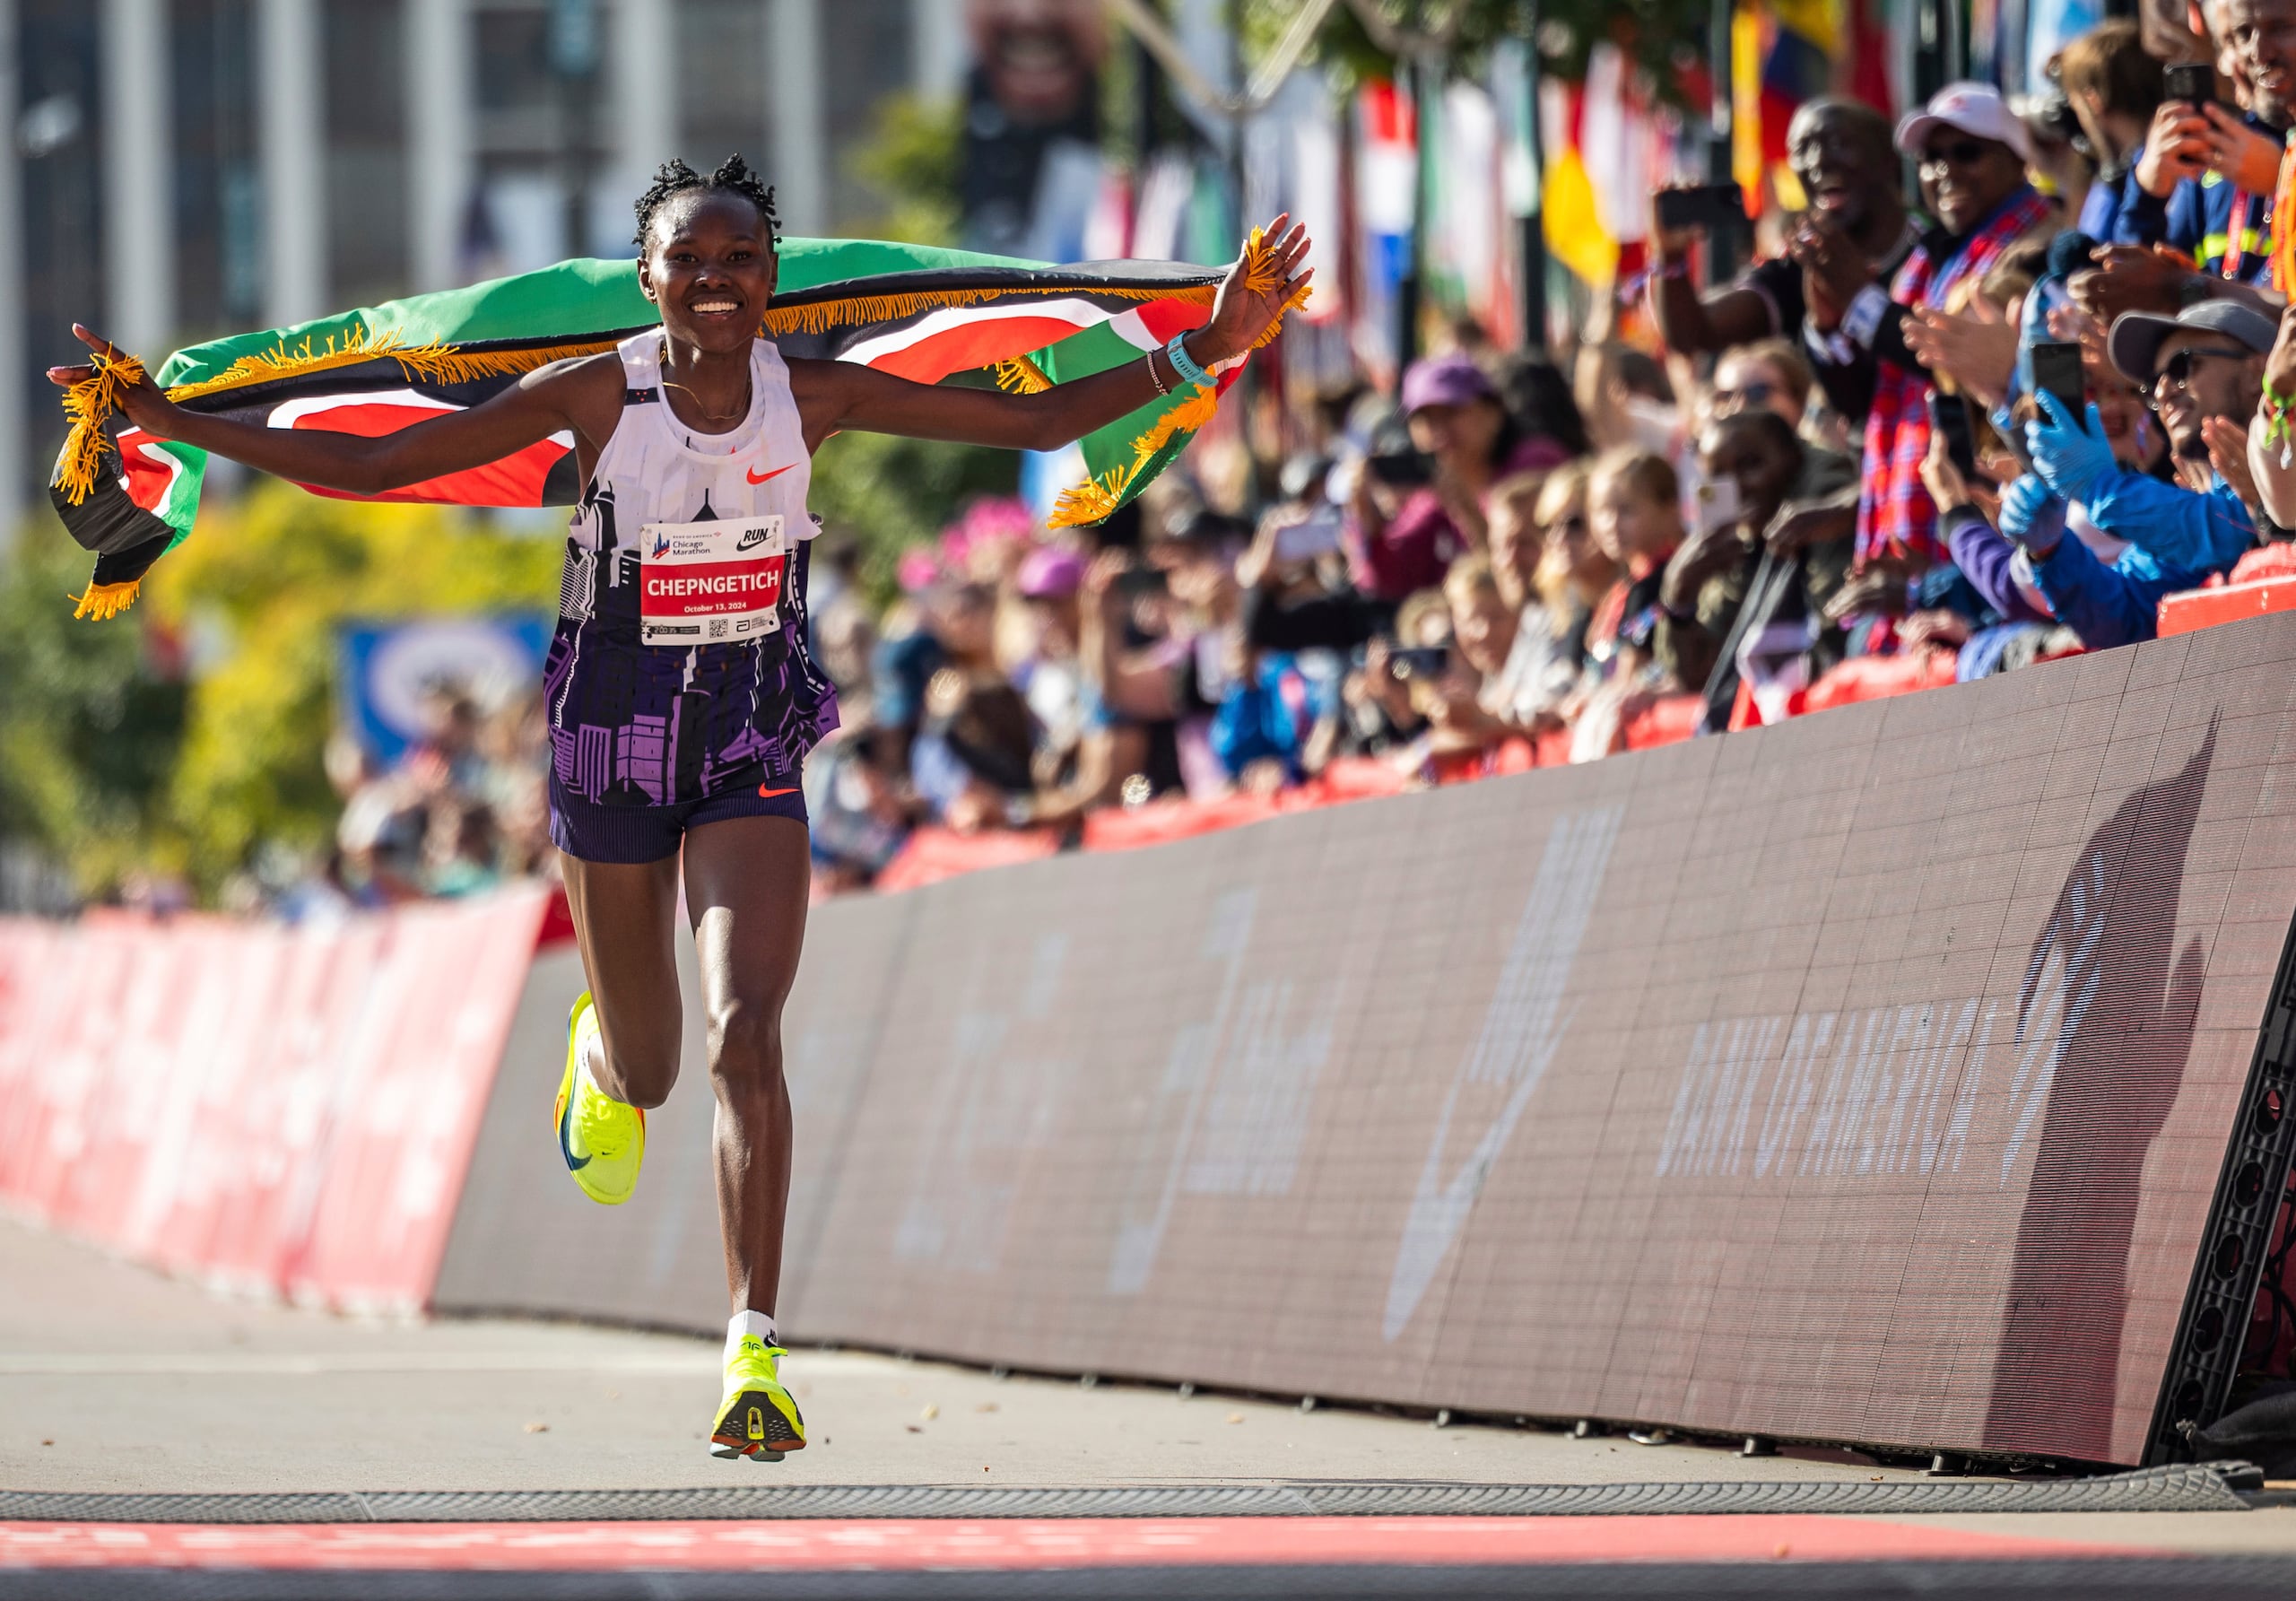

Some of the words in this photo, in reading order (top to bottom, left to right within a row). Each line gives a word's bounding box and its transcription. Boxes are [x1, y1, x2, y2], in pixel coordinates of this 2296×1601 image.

[743, 528, 769, 542] RUN
[673, 541, 703, 549] Chicago
[673, 548, 710, 556] Marathon
[647, 570, 779, 596] CHEPNGETICH
[683, 605, 713, 613] October
[715, 604, 727, 612] 13,
[728, 602, 747, 611] 2024
[1657, 1016, 1782, 1179] BANK
[1754, 1012, 1837, 1179] OF
[1796, 996, 1999, 1178] AMERICA
